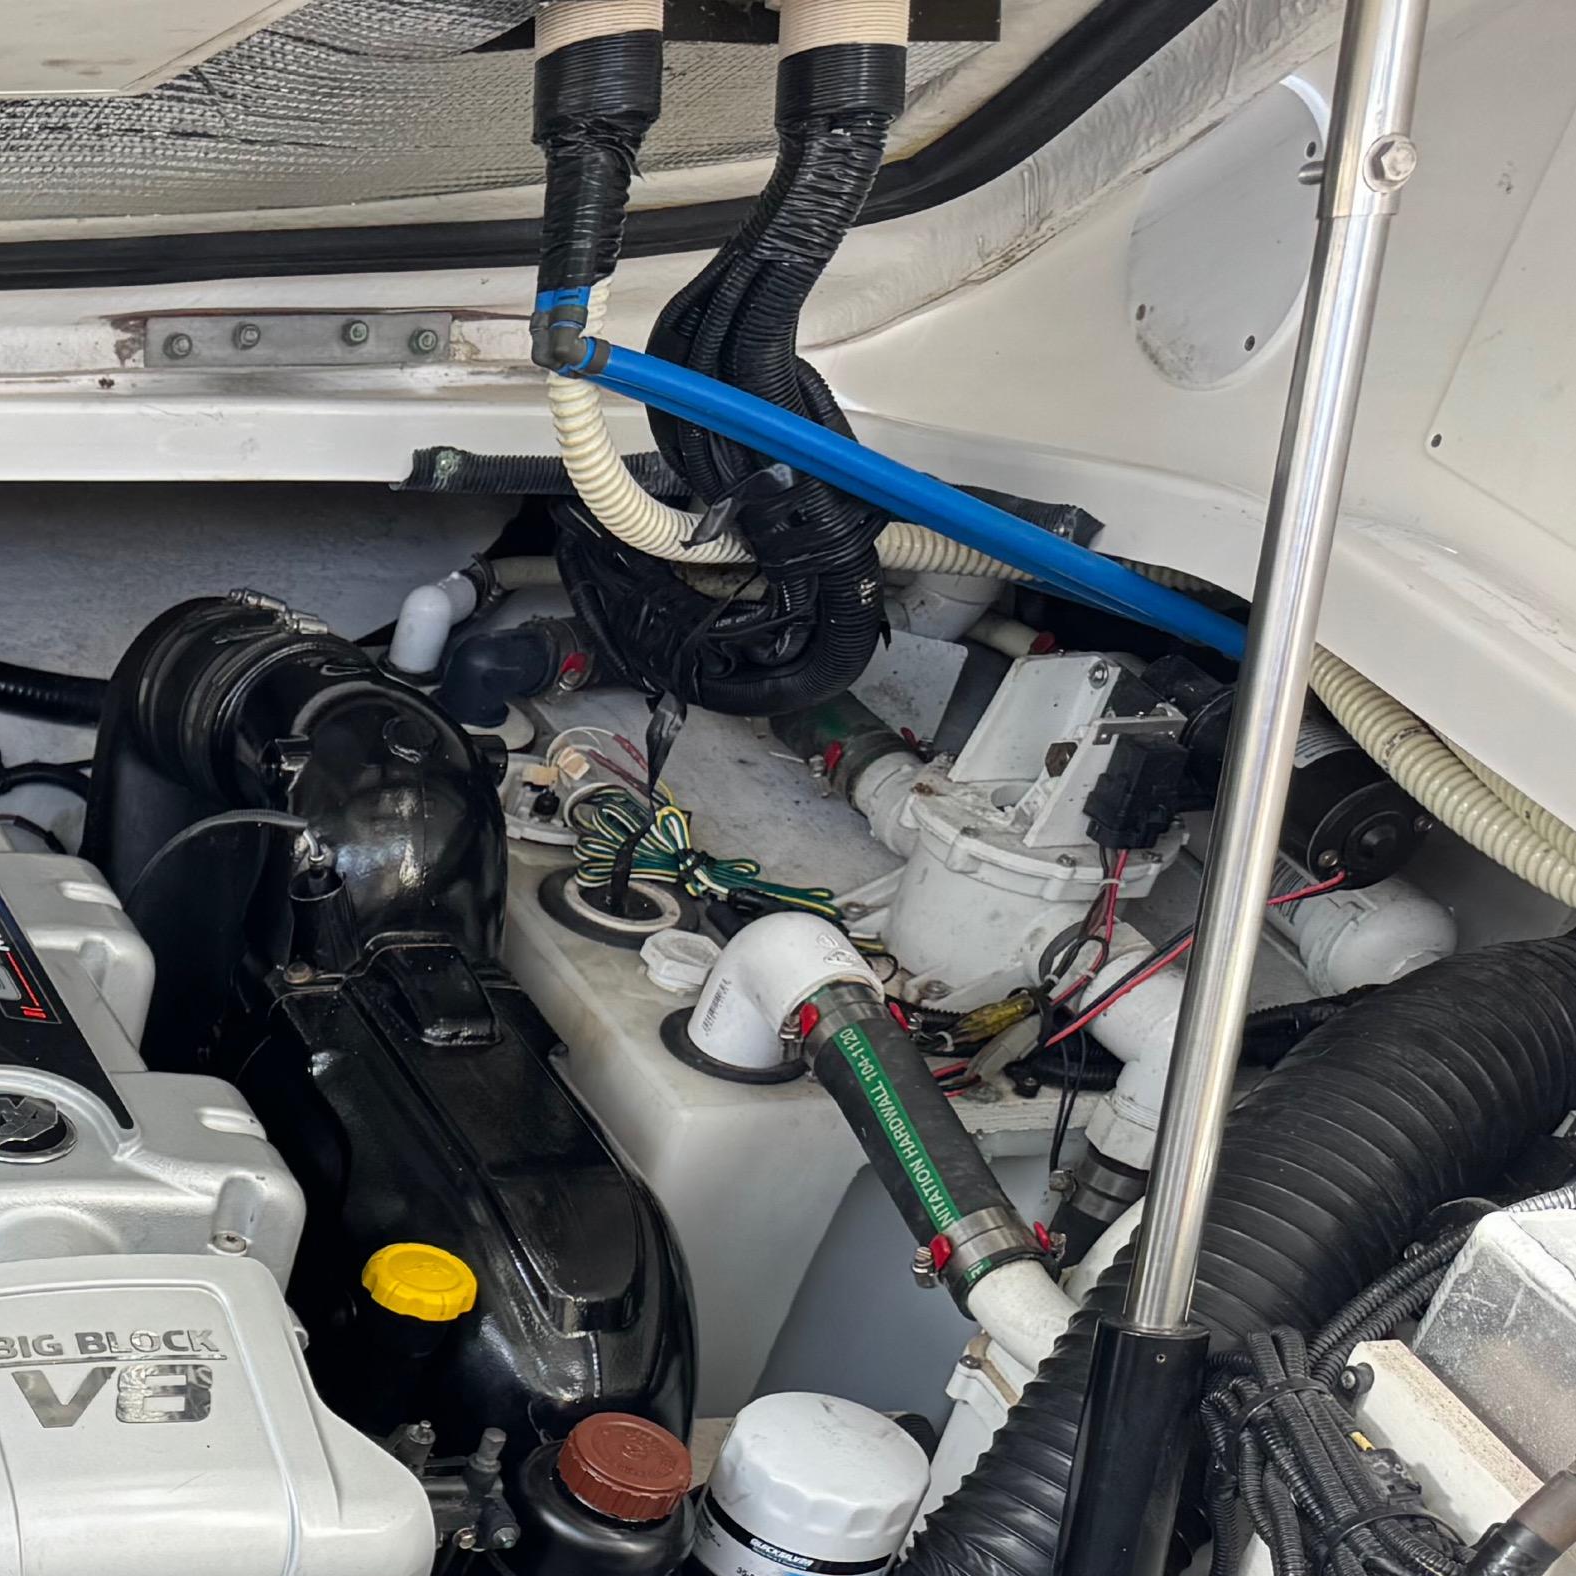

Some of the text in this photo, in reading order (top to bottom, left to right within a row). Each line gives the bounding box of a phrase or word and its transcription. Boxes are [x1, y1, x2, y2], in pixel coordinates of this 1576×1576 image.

[838, 1027, 955, 1227] NITATION HARDWALL 104-1120
[75, 1330, 219, 1354] BLOCK
[11, 1364, 213, 1428] V8
